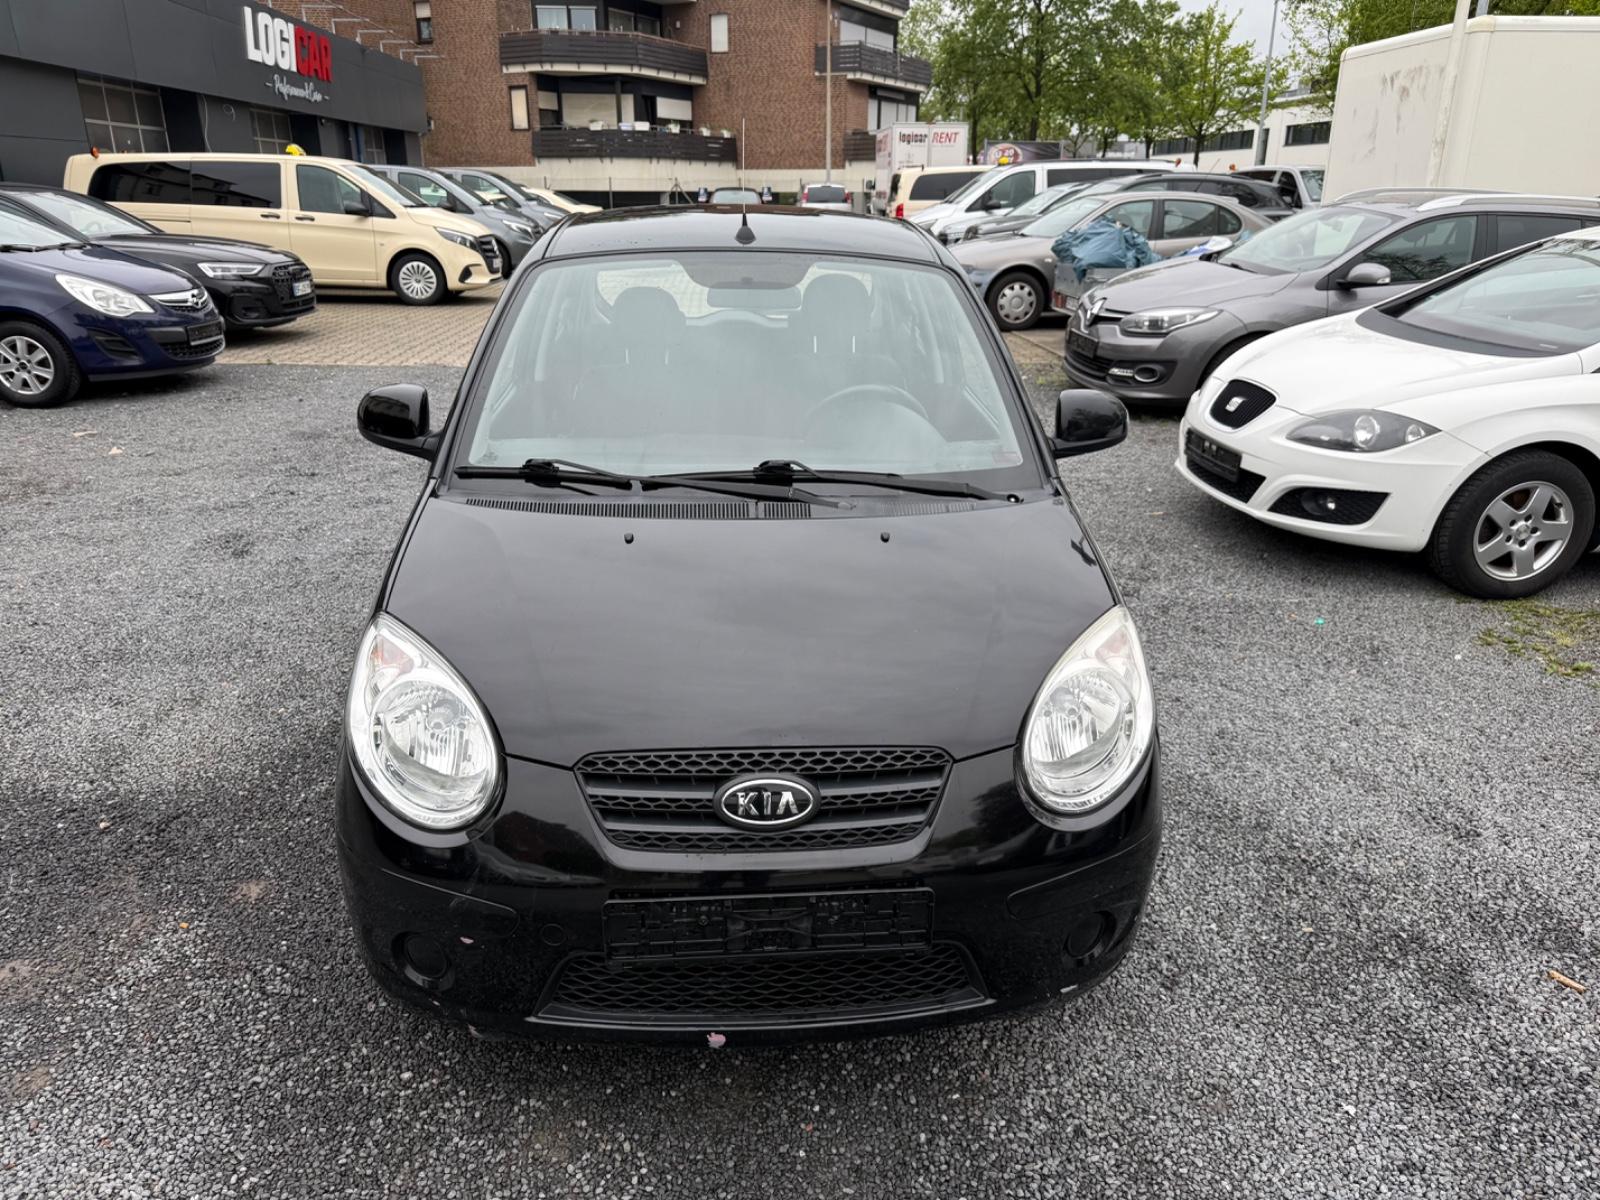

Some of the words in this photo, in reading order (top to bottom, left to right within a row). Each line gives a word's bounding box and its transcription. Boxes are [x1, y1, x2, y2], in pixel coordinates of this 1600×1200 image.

[243, 6, 332, 81] LOGICAR
[899, 131, 928, 144] logicar
[932, 132, 959, 144] RENT
[736, 791, 799, 815] KIA
